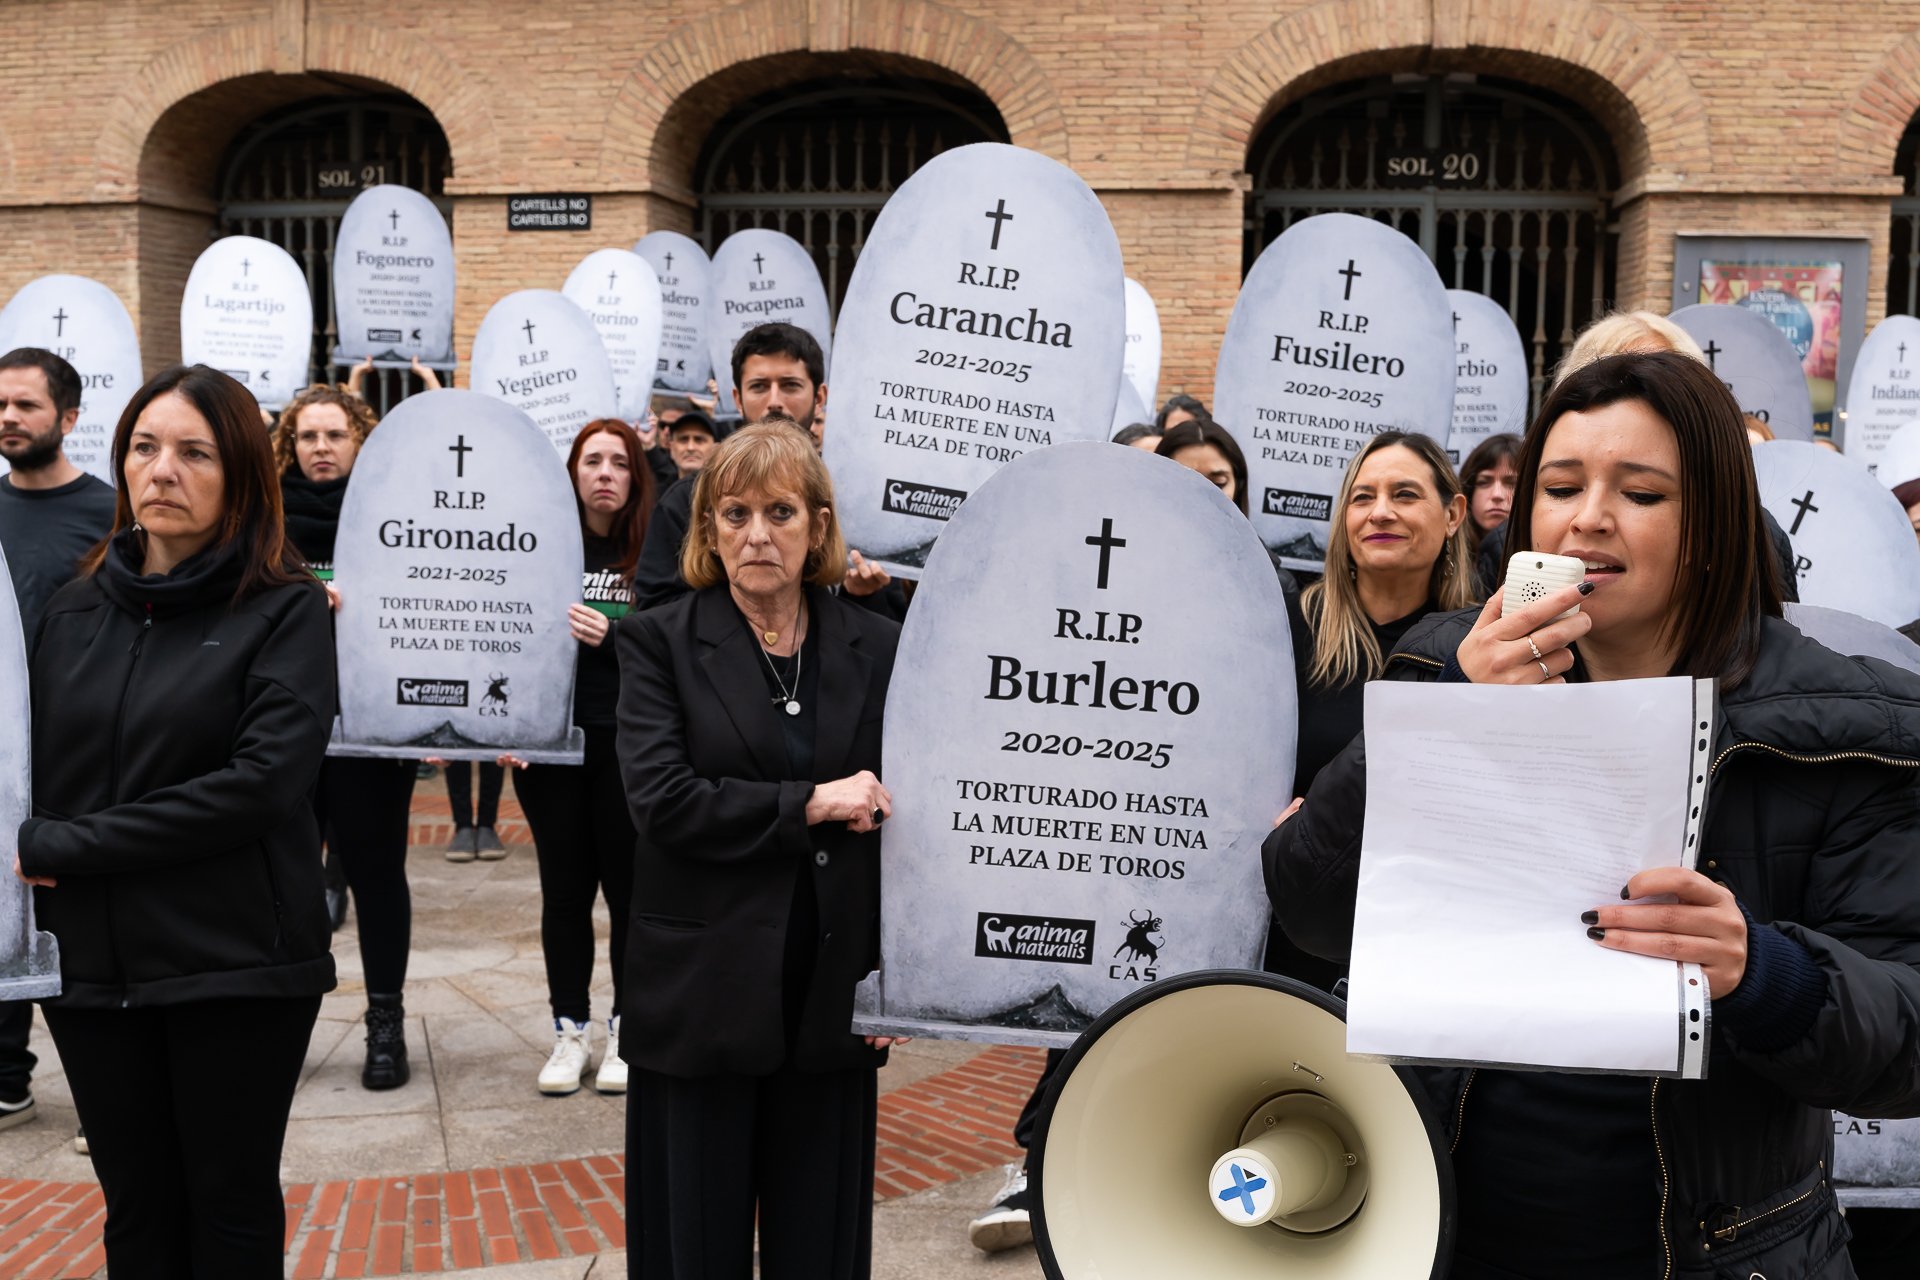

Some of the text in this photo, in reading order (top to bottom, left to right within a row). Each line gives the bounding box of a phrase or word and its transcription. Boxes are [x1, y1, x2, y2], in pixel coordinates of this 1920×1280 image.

[318, 165, 385, 189] SOL 21
[1387, 153, 1479, 180] SOL 20
[511, 198, 587, 211] CARTELLS NO
[511, 213, 587, 226] CARTELES NO
[356, 250, 434, 270] Fogonero
[957, 262, 1020, 291] R.I.P.
[205, 294, 285, 315] Lagartijo
[662, 291, 700, 306] ndero
[725, 295, 805, 316] Pocapena
[890, 292, 1073, 348] Carancha
[1318, 310, 1369, 334] R.I.P.
[915, 349, 1032, 383] 2021-2025
[1271, 335, 1405, 378] Fusilero
[1457, 359, 1498, 377] rbio
[497, 367, 577, 397] Yegüero
[880, 381, 1055, 422] TORTURADO HASTA
[1284, 381, 1384, 408] 2020-2025
[874, 404, 1052, 445] LA MUERTE EN UNA
[1256, 408, 1400, 435] TORTURADO HAST
[884, 429, 1023, 463] PLAZA DE TOR
[1253, 427, 1365, 451] LA MUERTE EN
[1262, 447, 1308, 465] PLAZA
[1313, 454, 1333, 467] DE
[433, 490, 485, 510] R.I.P.
[909, 502, 956, 518] naturali
[911, 489, 962, 508] anima
[1286, 494, 1329, 509] anima
[379, 519, 537, 553] Gironado
[407, 566, 508, 585] 2021-2025
[380, 597, 533, 615] TORTURADO HASTA
[378, 617, 534, 634] LA MUERTE EN UNA
[1054, 608, 1143, 644] R.I.P.
[390, 637, 521, 653] PLAZA DE TOROS
[421, 681, 465, 696] anima
[984, 655, 1200, 716] Burlero
[479, 707, 508, 717] CAS
[1001, 731, 1174, 769] 2020-2025
[957, 780, 1209, 818] TORTURADO HASTA
[952, 811, 1208, 850] LA MUERTE EN UNA
[969, 845, 1185, 880] PLAZA DE TOROS
[1016, 921, 1088, 945] anima
[1015, 941, 1086, 960] naturalis
[1109, 965, 1157, 982] CAS
[1834, 1120, 1881, 1135] CAS
